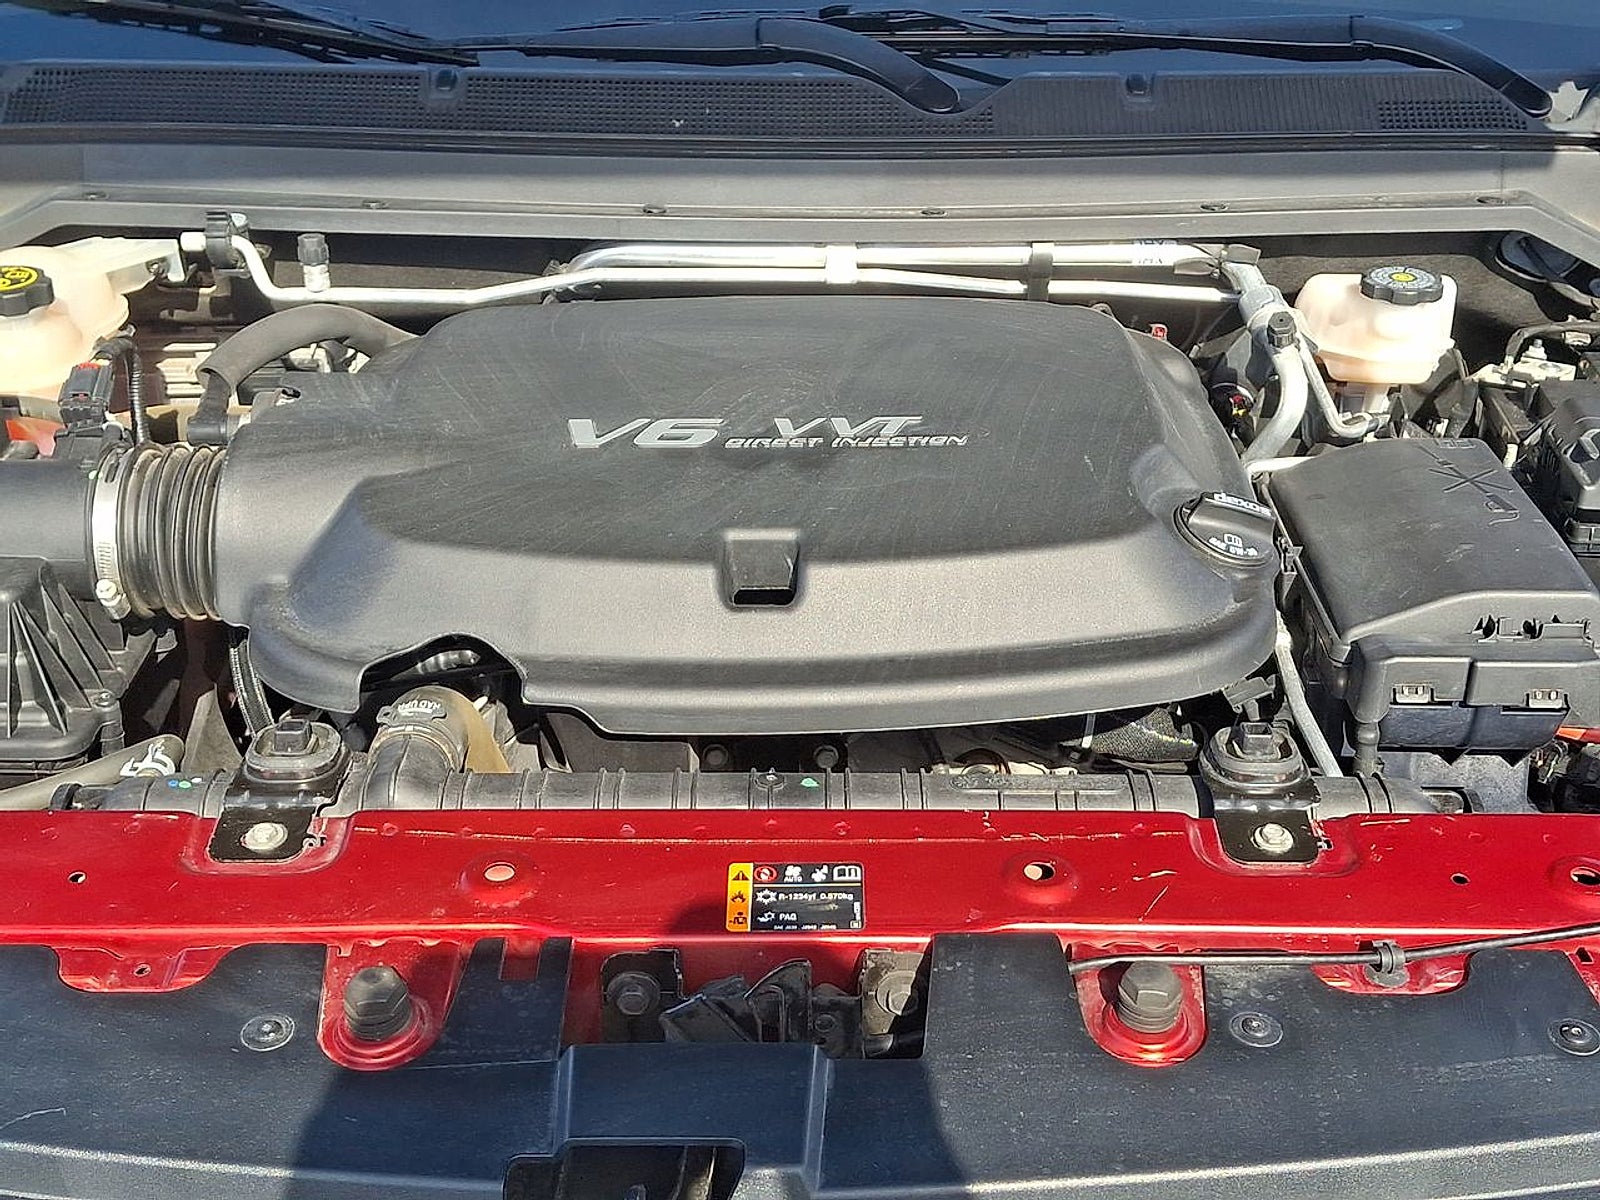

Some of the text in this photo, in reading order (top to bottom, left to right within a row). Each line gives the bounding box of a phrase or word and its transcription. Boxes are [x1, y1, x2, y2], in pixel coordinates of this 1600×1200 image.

[568, 416, 923, 448] V6 VVT
[724, 436, 969, 448] DIRECT INJECTION
[1213, 493, 1272, 516] dexos
[778, 893, 817, 902] R-1234yf
